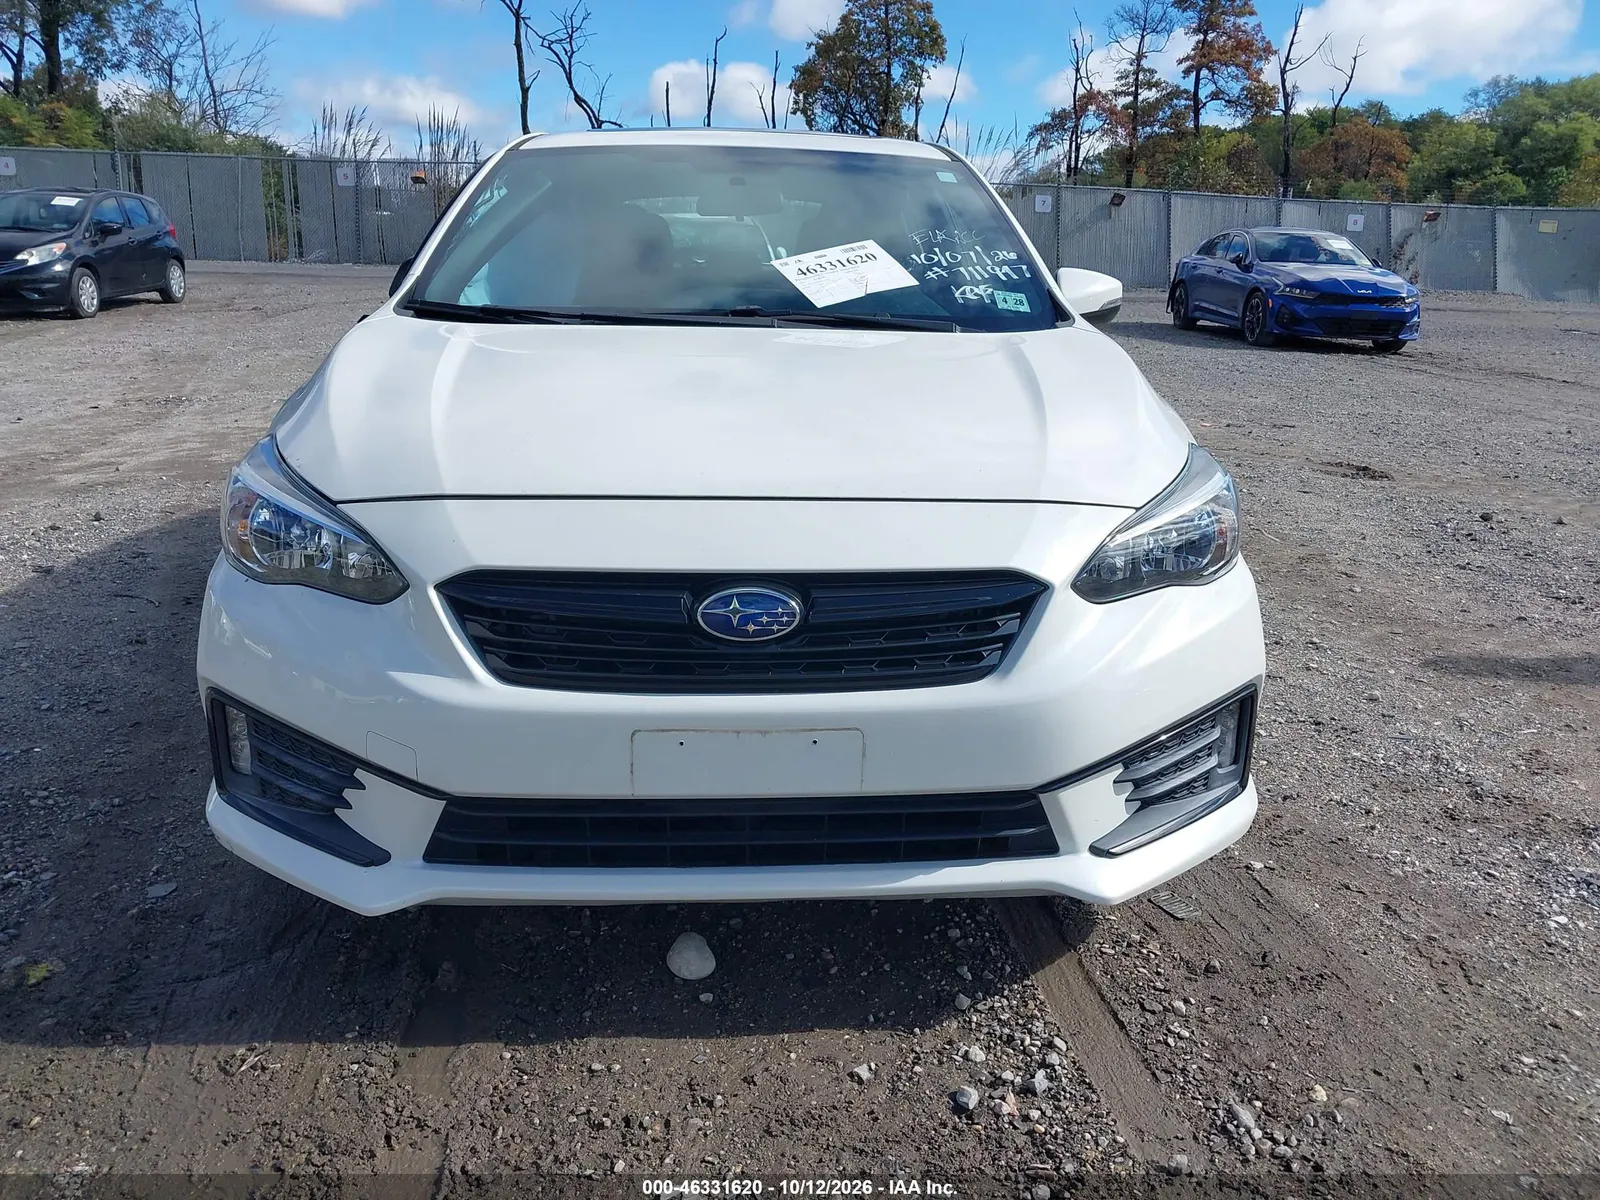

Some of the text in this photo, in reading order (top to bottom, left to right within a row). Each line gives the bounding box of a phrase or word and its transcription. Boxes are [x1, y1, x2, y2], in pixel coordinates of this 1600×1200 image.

[1040, 199, 1047, 207] 7
[796, 252, 878, 277] 46331620
[1001, 296, 1008, 305] 4
[1012, 297, 1025, 307] 28
